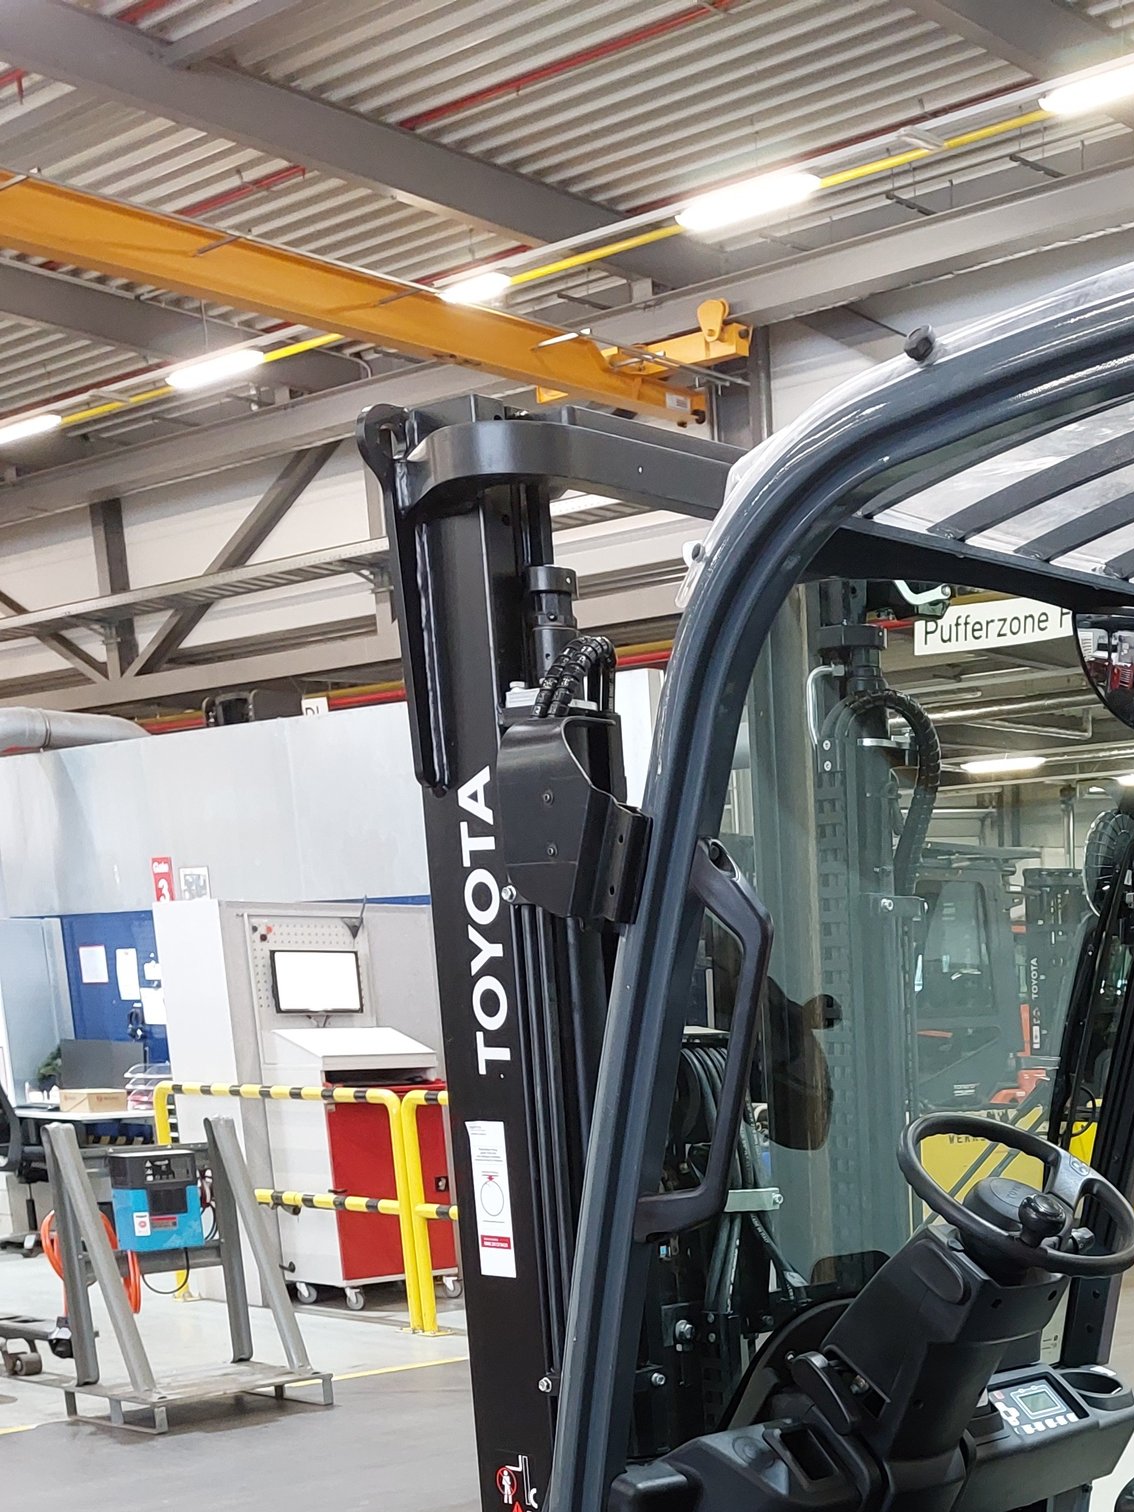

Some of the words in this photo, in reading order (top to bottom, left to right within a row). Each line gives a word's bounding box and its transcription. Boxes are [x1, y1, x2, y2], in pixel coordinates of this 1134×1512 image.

[924, 611, 1049, 646] Pufferzone
[457, 764, 511, 1076] TOYOTA
[1030, 957, 1039, 1001] TOYOTA
